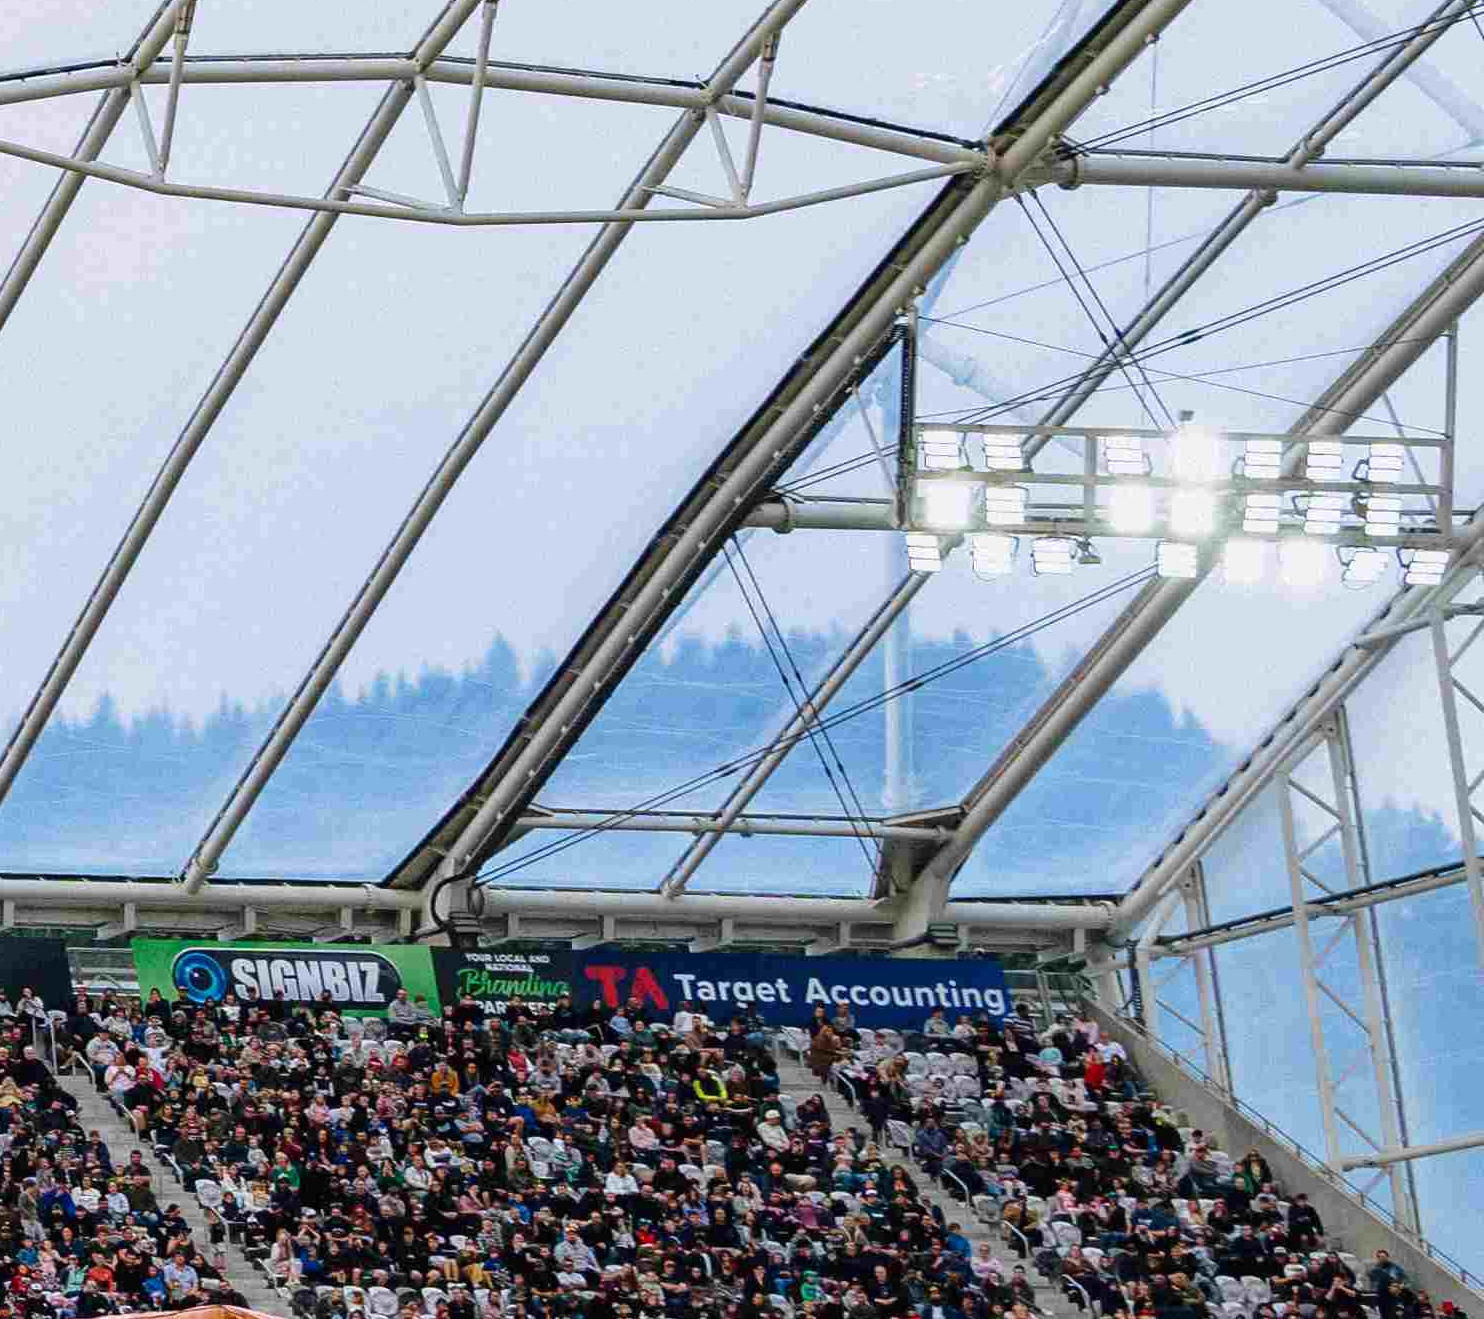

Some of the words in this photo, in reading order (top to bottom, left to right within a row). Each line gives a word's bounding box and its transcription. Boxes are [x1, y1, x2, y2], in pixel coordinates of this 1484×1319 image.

[231, 958, 385, 1002] SIGNBIZ
[465, 953, 493, 963] YOUR
[494, 953, 527, 963] LOCAL
[528, 954, 551, 964] AND
[672, 973, 792, 1008] Target
[805, 977, 1006, 1016] Accounting
